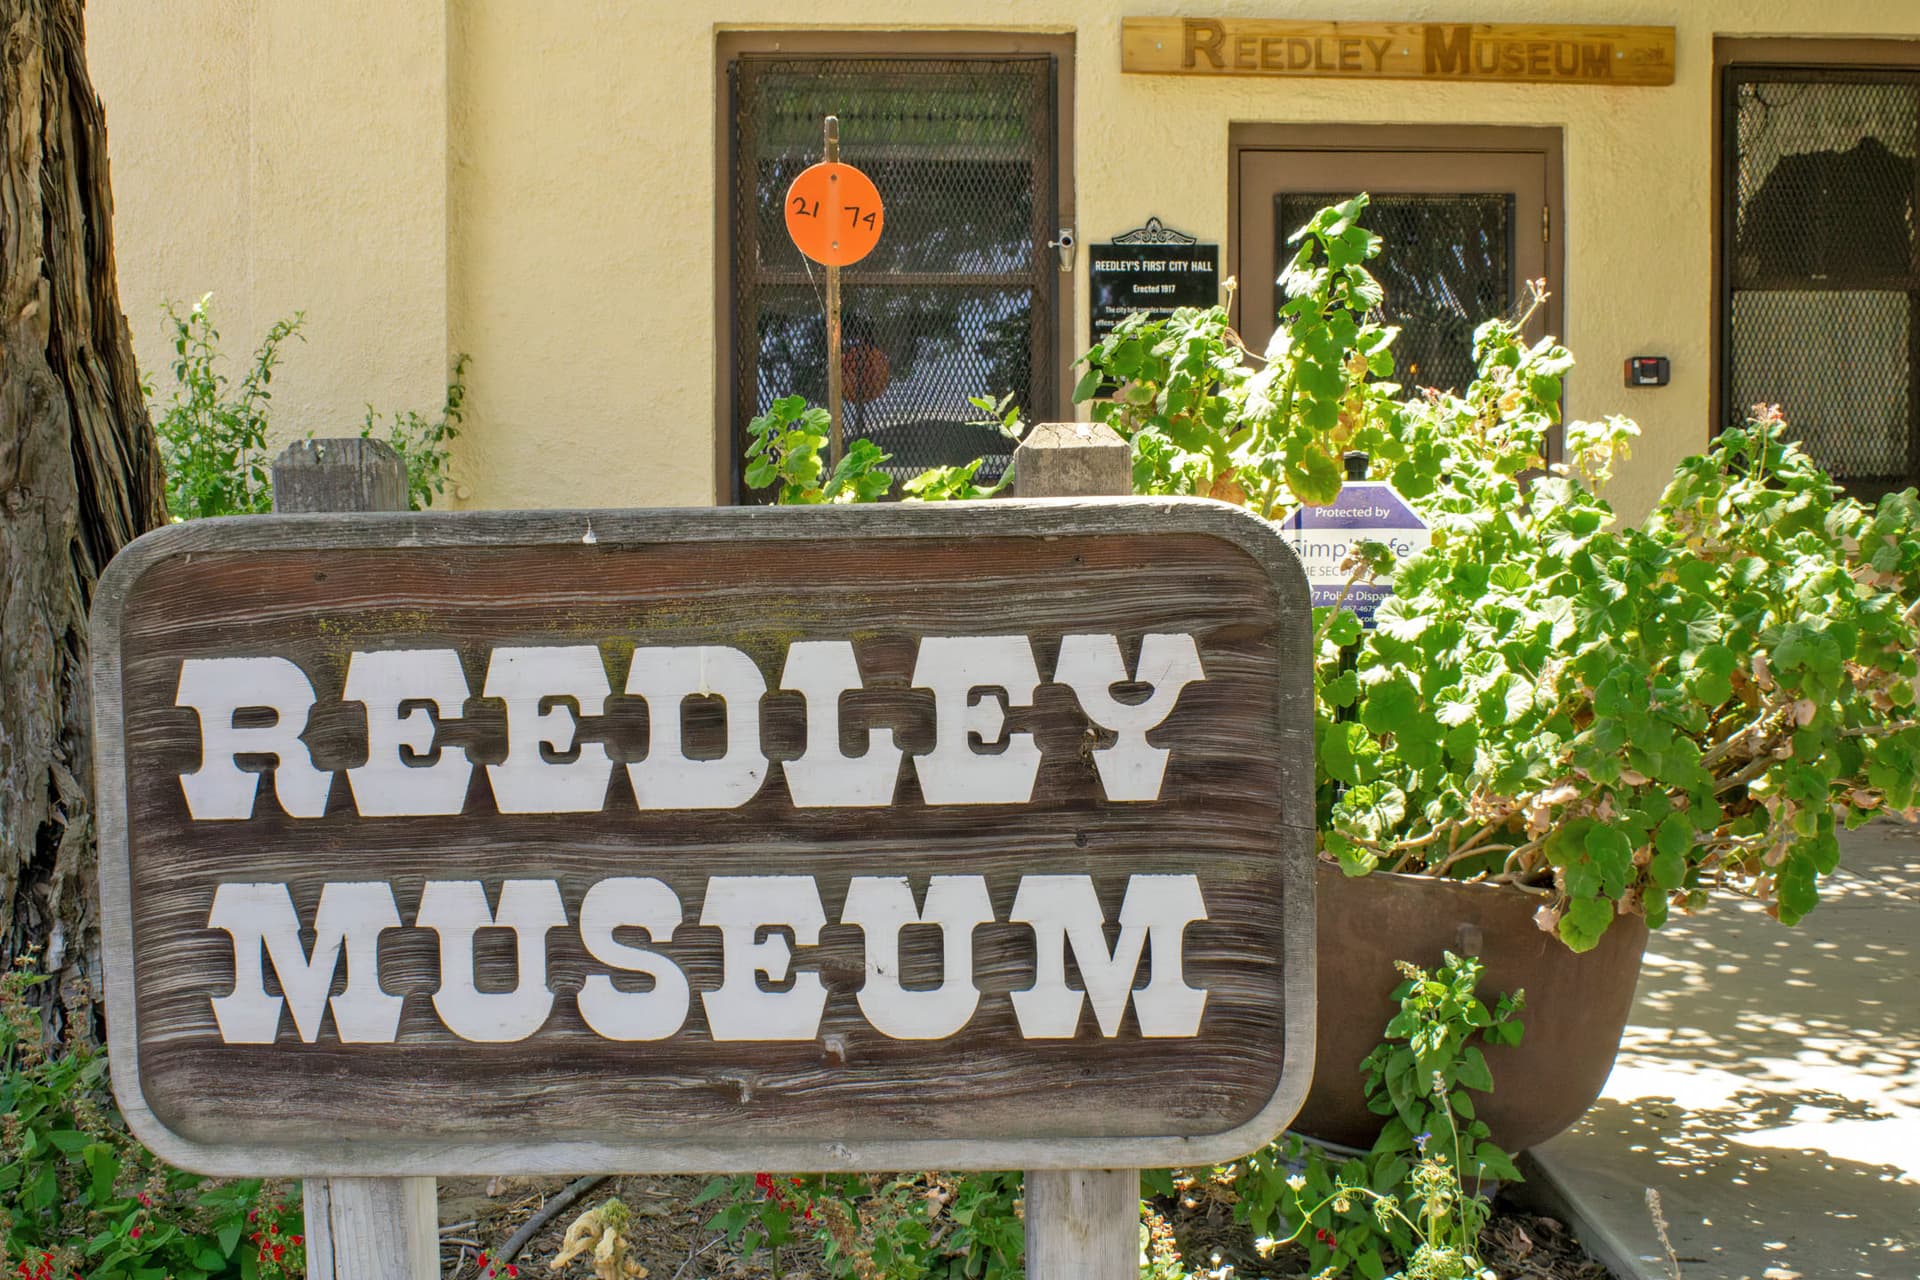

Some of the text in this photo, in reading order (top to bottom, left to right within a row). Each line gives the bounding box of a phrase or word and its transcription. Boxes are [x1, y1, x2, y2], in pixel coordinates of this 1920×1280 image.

[1182, 18, 1614, 78] REEDLEY MUSEUM
[792, 197, 819, 218] 21
[1095, 261, 1213, 272] REEDLEY'S FIRST CITY HALL
[1133, 284, 1176, 293] Erected 1917
[1315, 507, 1390, 519] Protected by
[174, 634, 1205, 820] REEDLEY
[207, 874, 1209, 1045] MUSEUM
